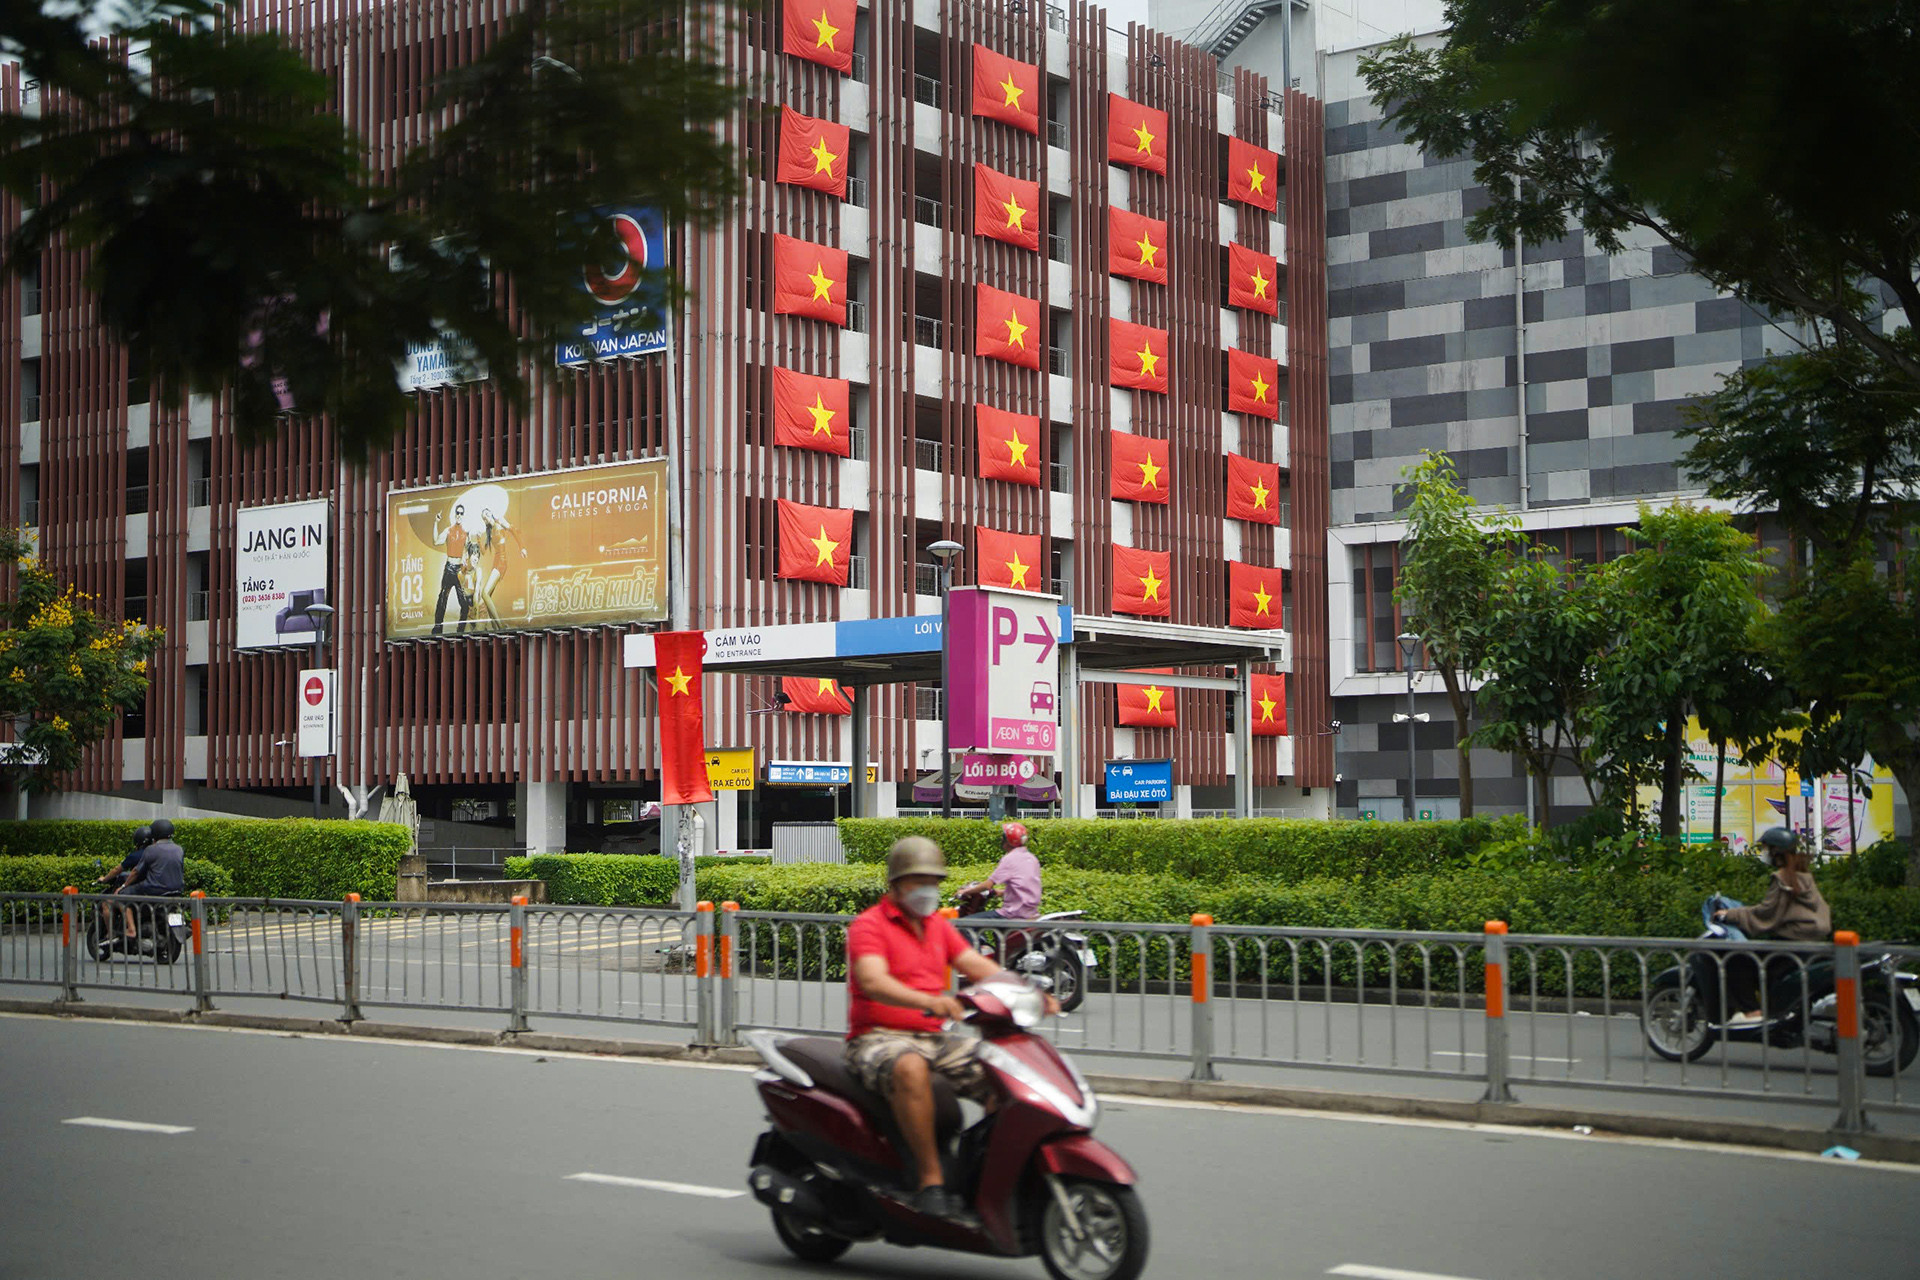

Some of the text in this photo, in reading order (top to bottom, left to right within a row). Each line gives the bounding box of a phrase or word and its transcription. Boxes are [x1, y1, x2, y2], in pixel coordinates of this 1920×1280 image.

[620, 330, 665, 350] JAPAN
[551, 485, 648, 510] CALIFORNIA
[551, 502, 649, 520] FITNESS & YOGA
[268, 579, 275, 591] 2
[401, 574, 423, 605] 03
[560, 569, 655, 611] SỐNG KHỎE
[915, 620, 933, 635] LỐI
[740, 632, 761, 645] VÀO
[992, 606, 1018, 666] P
[727, 648, 762, 657] ENTRANCE
[1042, 728, 1049, 743] 6
[965, 761, 1017, 778] LỐI ĐI BỘ
[735, 776, 751, 786] ÔTÔ
[1110, 789, 1122, 799] BÃI
[1140, 790, 1150, 798] XE
[1151, 788, 1167, 798] ÔTÔ
